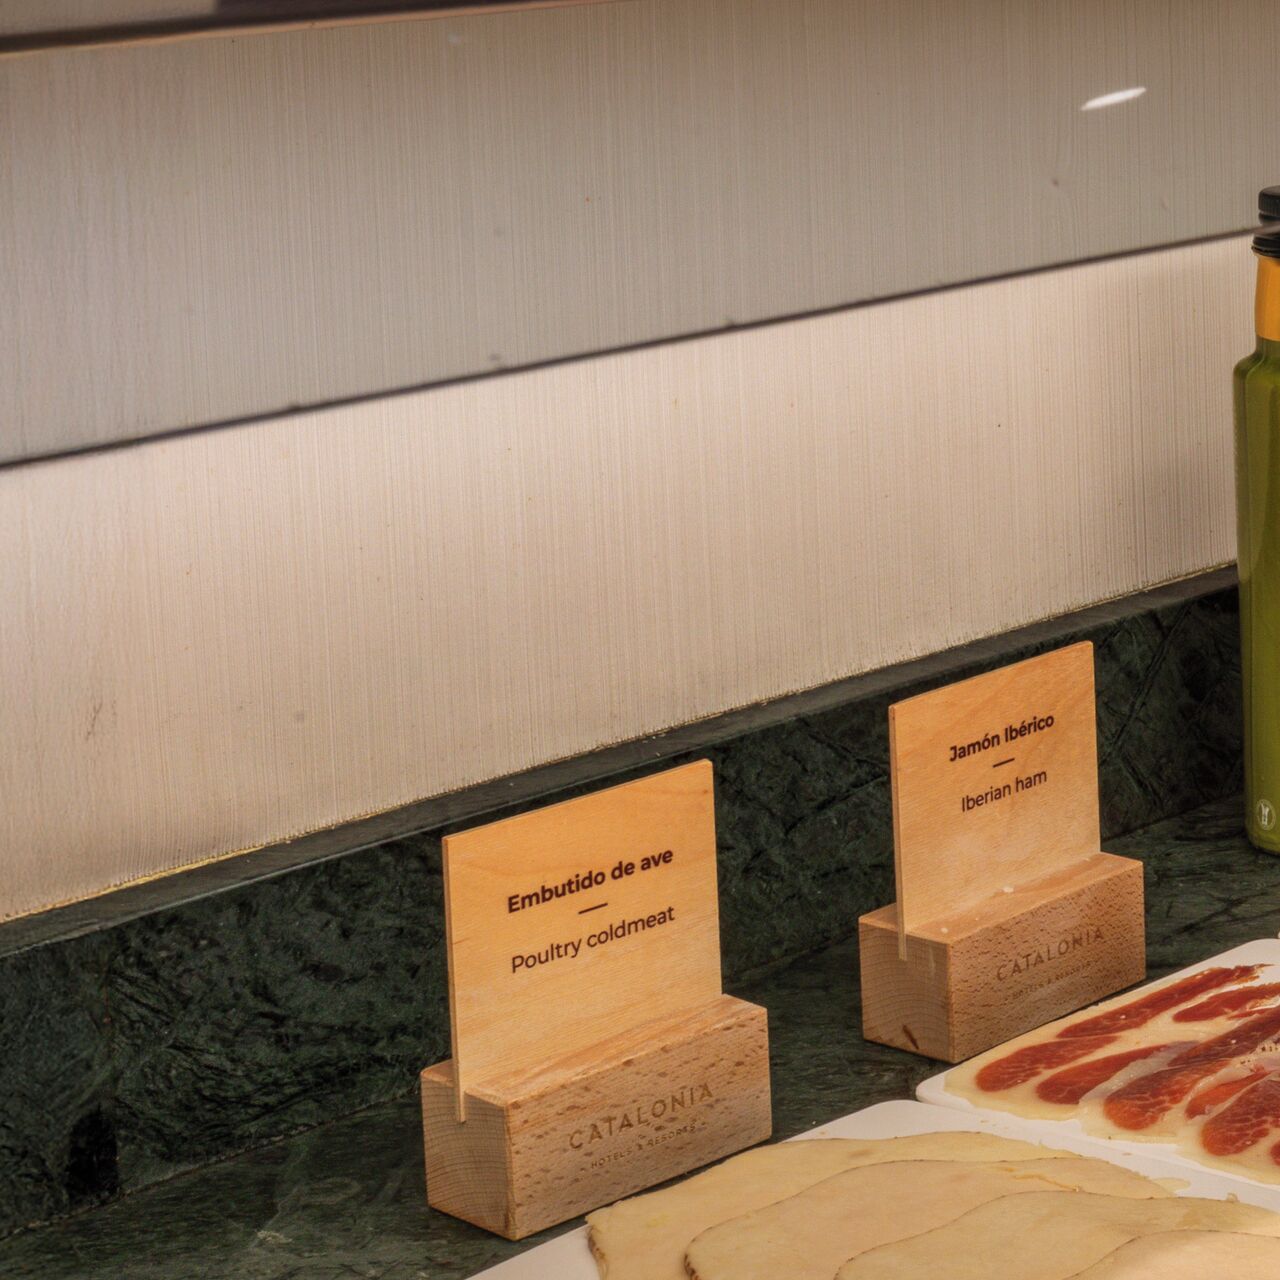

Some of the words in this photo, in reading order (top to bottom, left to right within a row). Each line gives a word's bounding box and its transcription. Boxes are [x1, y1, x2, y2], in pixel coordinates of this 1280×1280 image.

[949, 732, 1000, 762] Jamón
[1004, 715, 1055, 743] Ibérico
[961, 784, 1011, 813] Iberian
[1015, 770, 1047, 793] ham
[507, 870, 606, 914] Embutido
[611, 861, 636, 880] de
[640, 850, 674, 872] ave
[511, 938, 583, 974] Poultry
[586, 906, 675, 948] coldmeat
[996, 927, 1104, 982] CATALONIA
[569, 1082, 713, 1149] CATALONIA
[591, 1149, 632, 1170] HOTELS
[647, 1124, 696, 1147] RESORTS
